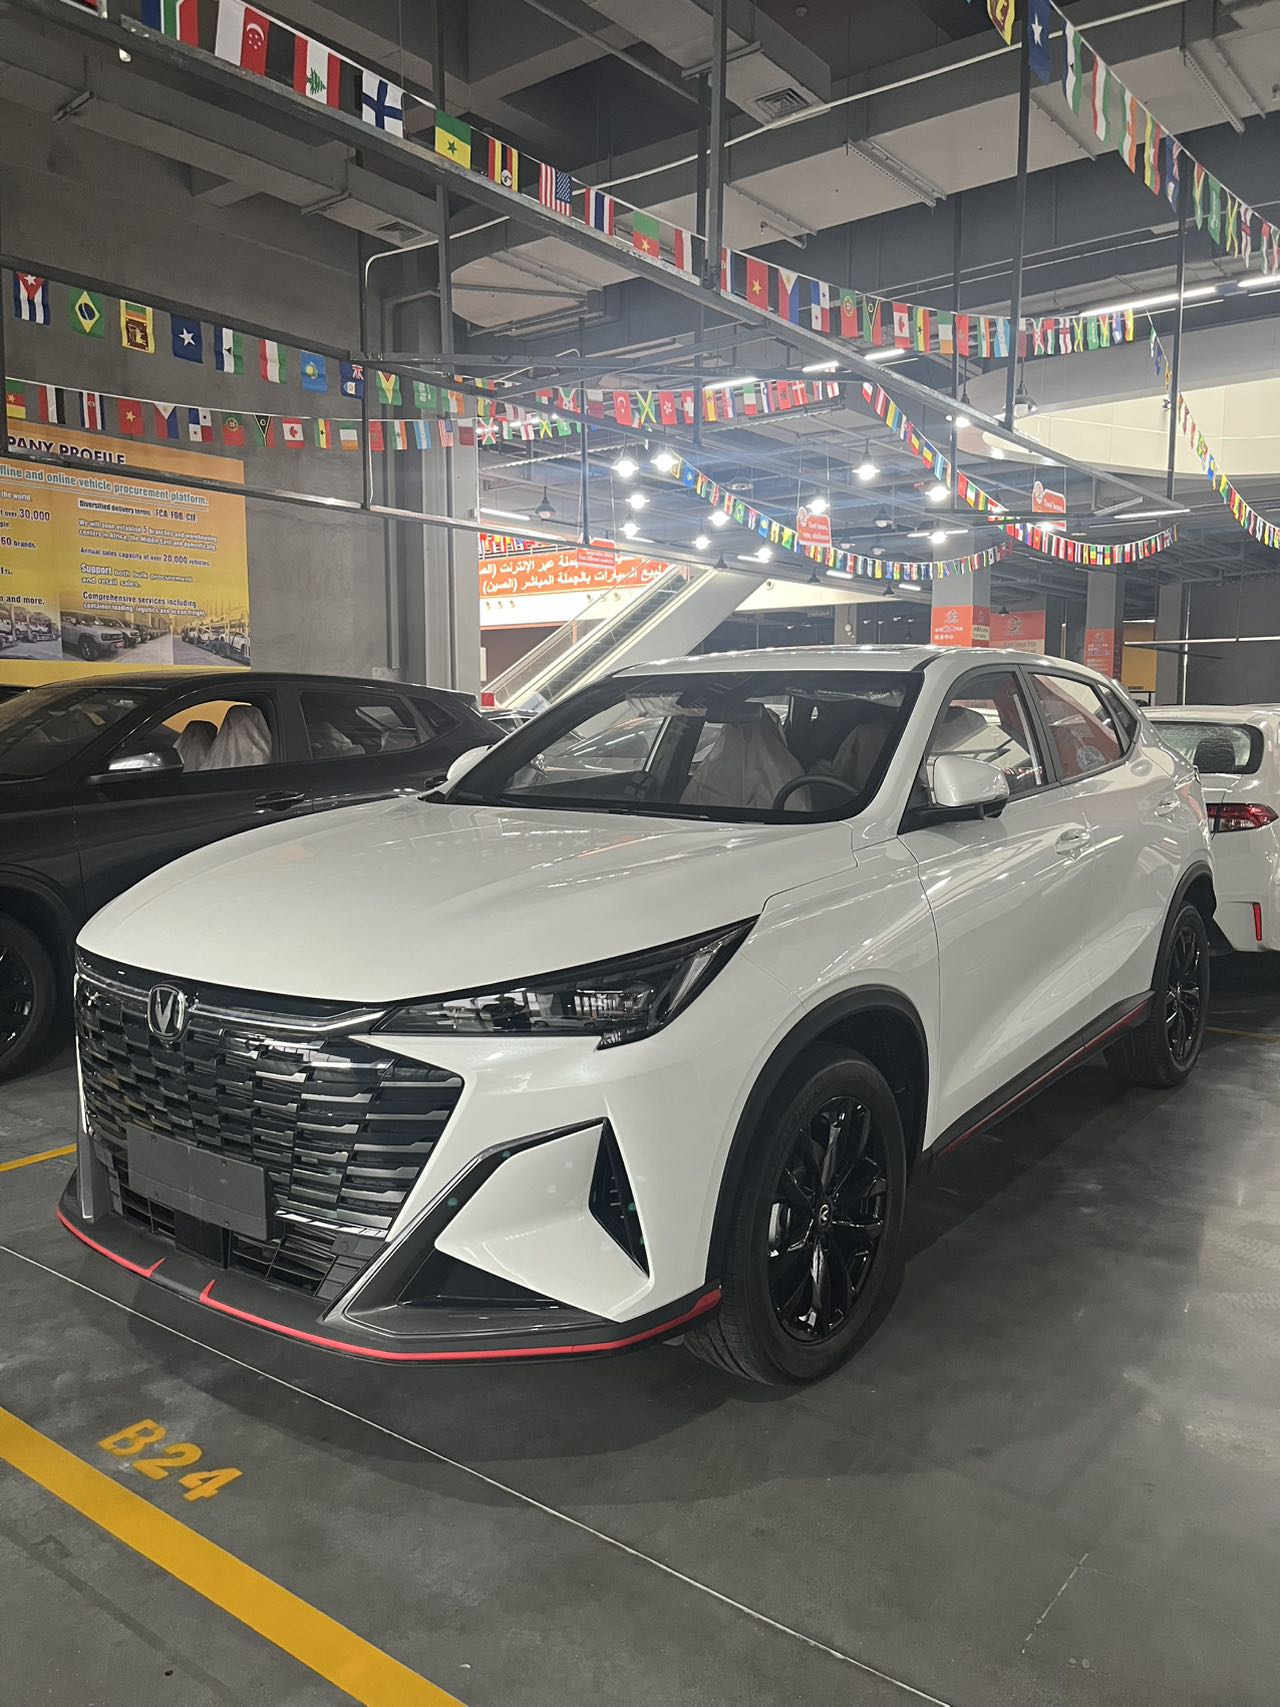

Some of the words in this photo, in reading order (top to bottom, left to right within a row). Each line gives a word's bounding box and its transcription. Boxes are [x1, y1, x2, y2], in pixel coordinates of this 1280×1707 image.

[25, 470, 43, 480] and
[47, 473, 76, 485] online
[79, 478, 111, 490] vehicle
[114, 484, 168, 499] procurement
[171, 491, 208, 504] platform.
[19, 508, 50, 521] 30,000
[80, 547, 101, 555] Annual
[80, 563, 112, 576] Support
[114, 569, 131, 577] both
[83, 591, 136, 603] Comprehensive
[138, 596, 167, 605] services
[167, 599, 197, 608] including
[97, 1418, 243, 1502] B24
